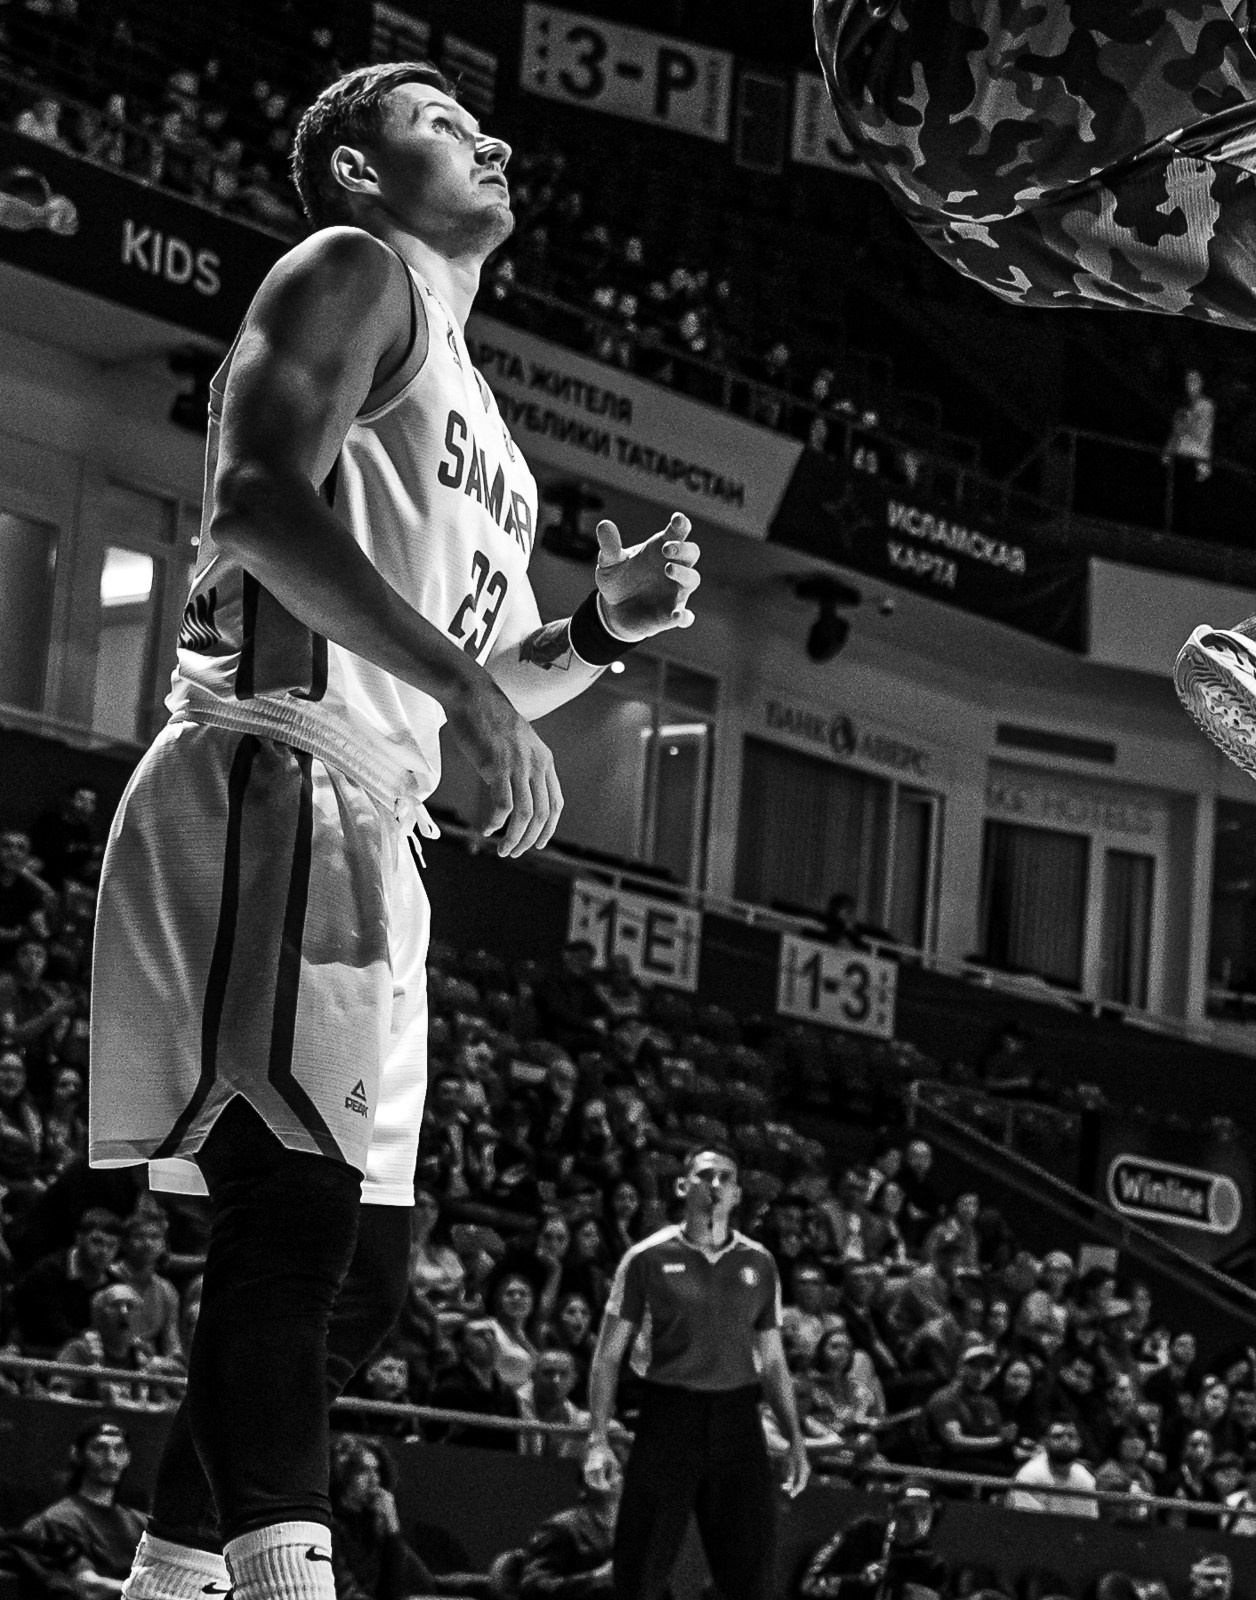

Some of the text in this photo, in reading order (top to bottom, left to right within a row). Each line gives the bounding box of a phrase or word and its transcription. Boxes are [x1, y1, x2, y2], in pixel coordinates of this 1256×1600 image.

[121, 219, 222, 297] KIDS
[528, 361, 634, 426] ЖИТЕЛЯ
[615, 434, 746, 508] ТАТАРСТАН
[887, 502, 1027, 573] ИСЛАМСКАЯ
[888, 543, 957, 585] КАРТА
[447, 549, 509, 668] 23
[765, 701, 828, 746] БАНК
[345, 1096, 369, 1119] PEAK
[1119, 1167, 1204, 1215] Winline
